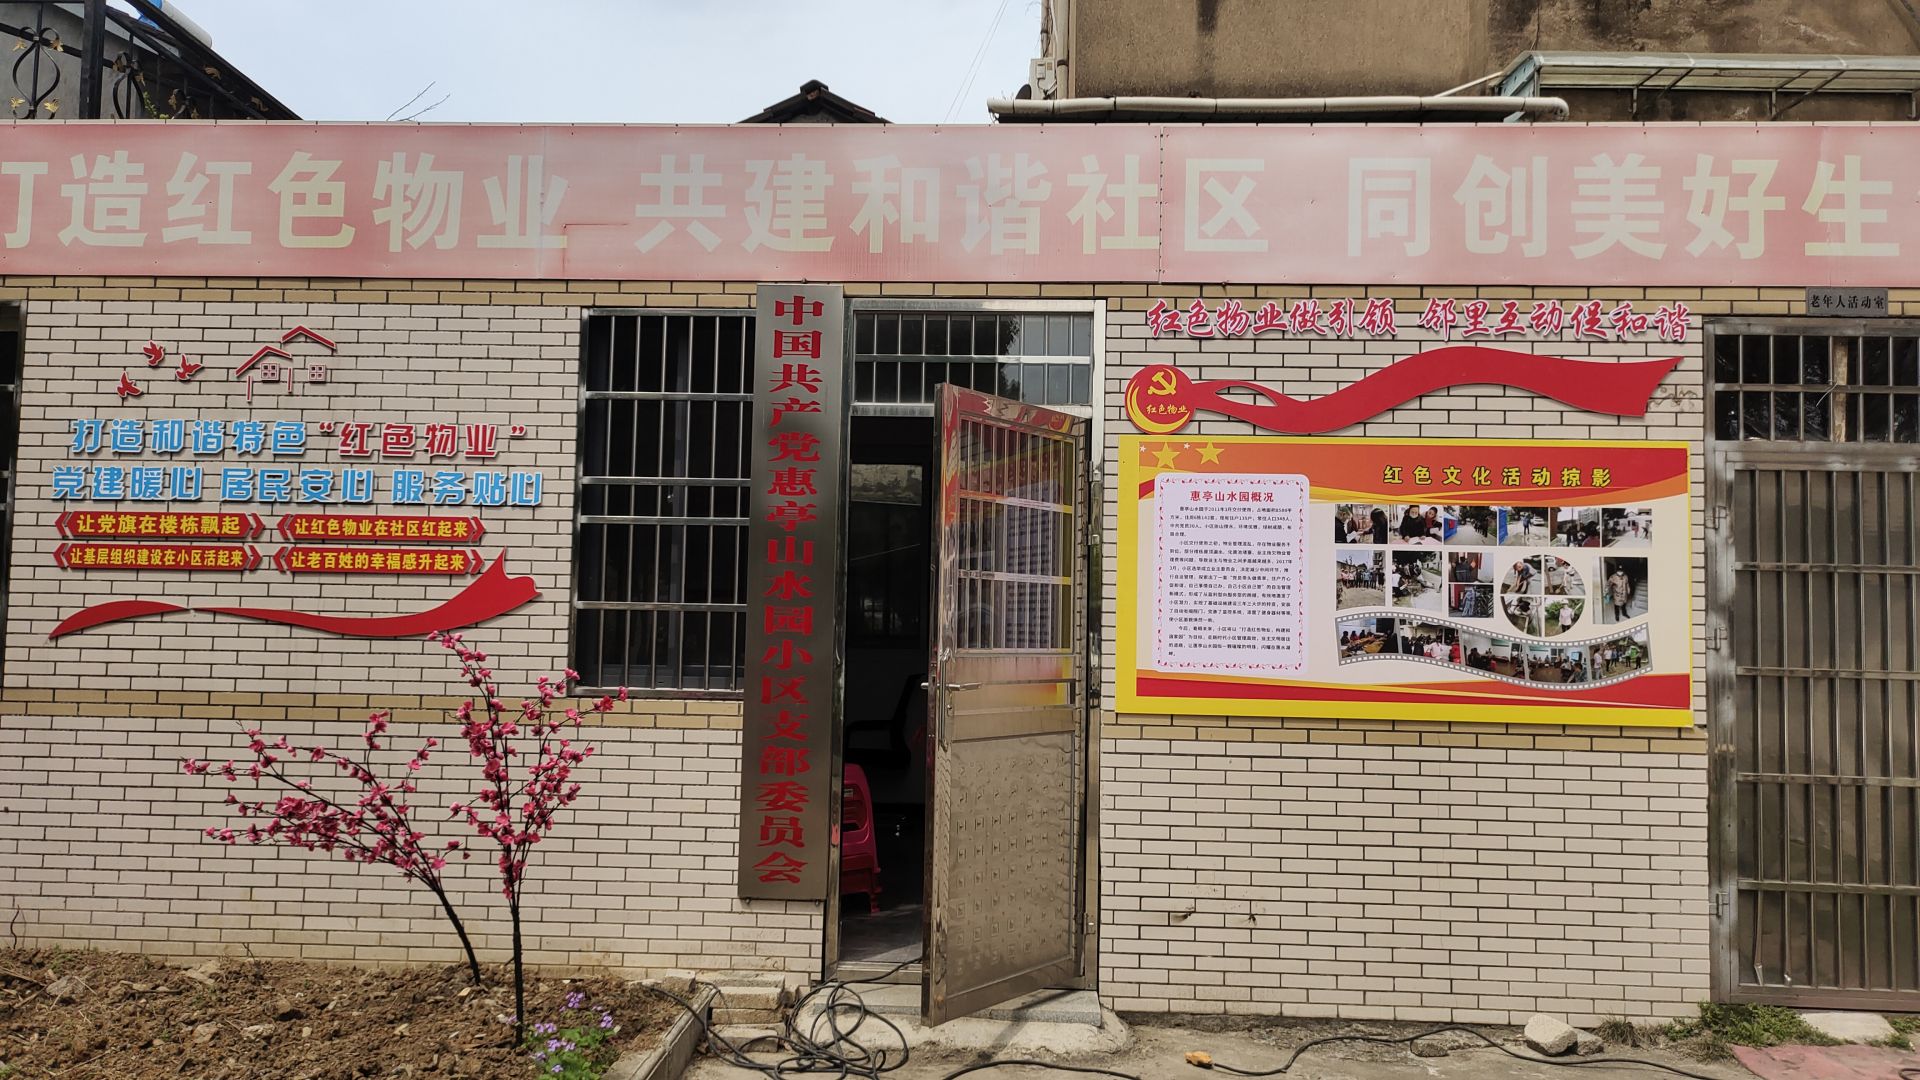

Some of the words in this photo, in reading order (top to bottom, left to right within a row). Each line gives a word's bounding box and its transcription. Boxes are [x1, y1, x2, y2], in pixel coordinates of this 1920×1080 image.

[634, 152, 1268, 255] 共建和谐社区
[1348, 152, 1900, 260] 同创美好生
[1811, 294, 1885, 309] 老年人活动室
[1146, 298, 1399, 340] 红色物业做引领
[1417, 298, 1691, 343] 邻里互动促和谐
[1146, 403, 1188, 415] 红色物业
[52, 465, 204, 500] 党建暖心
[220, 467, 374, 504] 居民安心
[391, 469, 543, 506] 服务贴心
[1384, 465, 1612, 488] 红色文化活动掠影
[1189, 490, 1275, 503] 惠亭山水园概况
[76, 514, 241, 535] 让党旗在楼栋飘起
[294, 517, 468, 538] 让红色物业在社区红起来
[70, 547, 244, 568] 让基层组织建设在小区活起来
[290, 551, 466, 571] 让老百姓的幸福感升起来
[752, 295, 824, 884] 中国共产党惠亭山水园小区支部委员会
